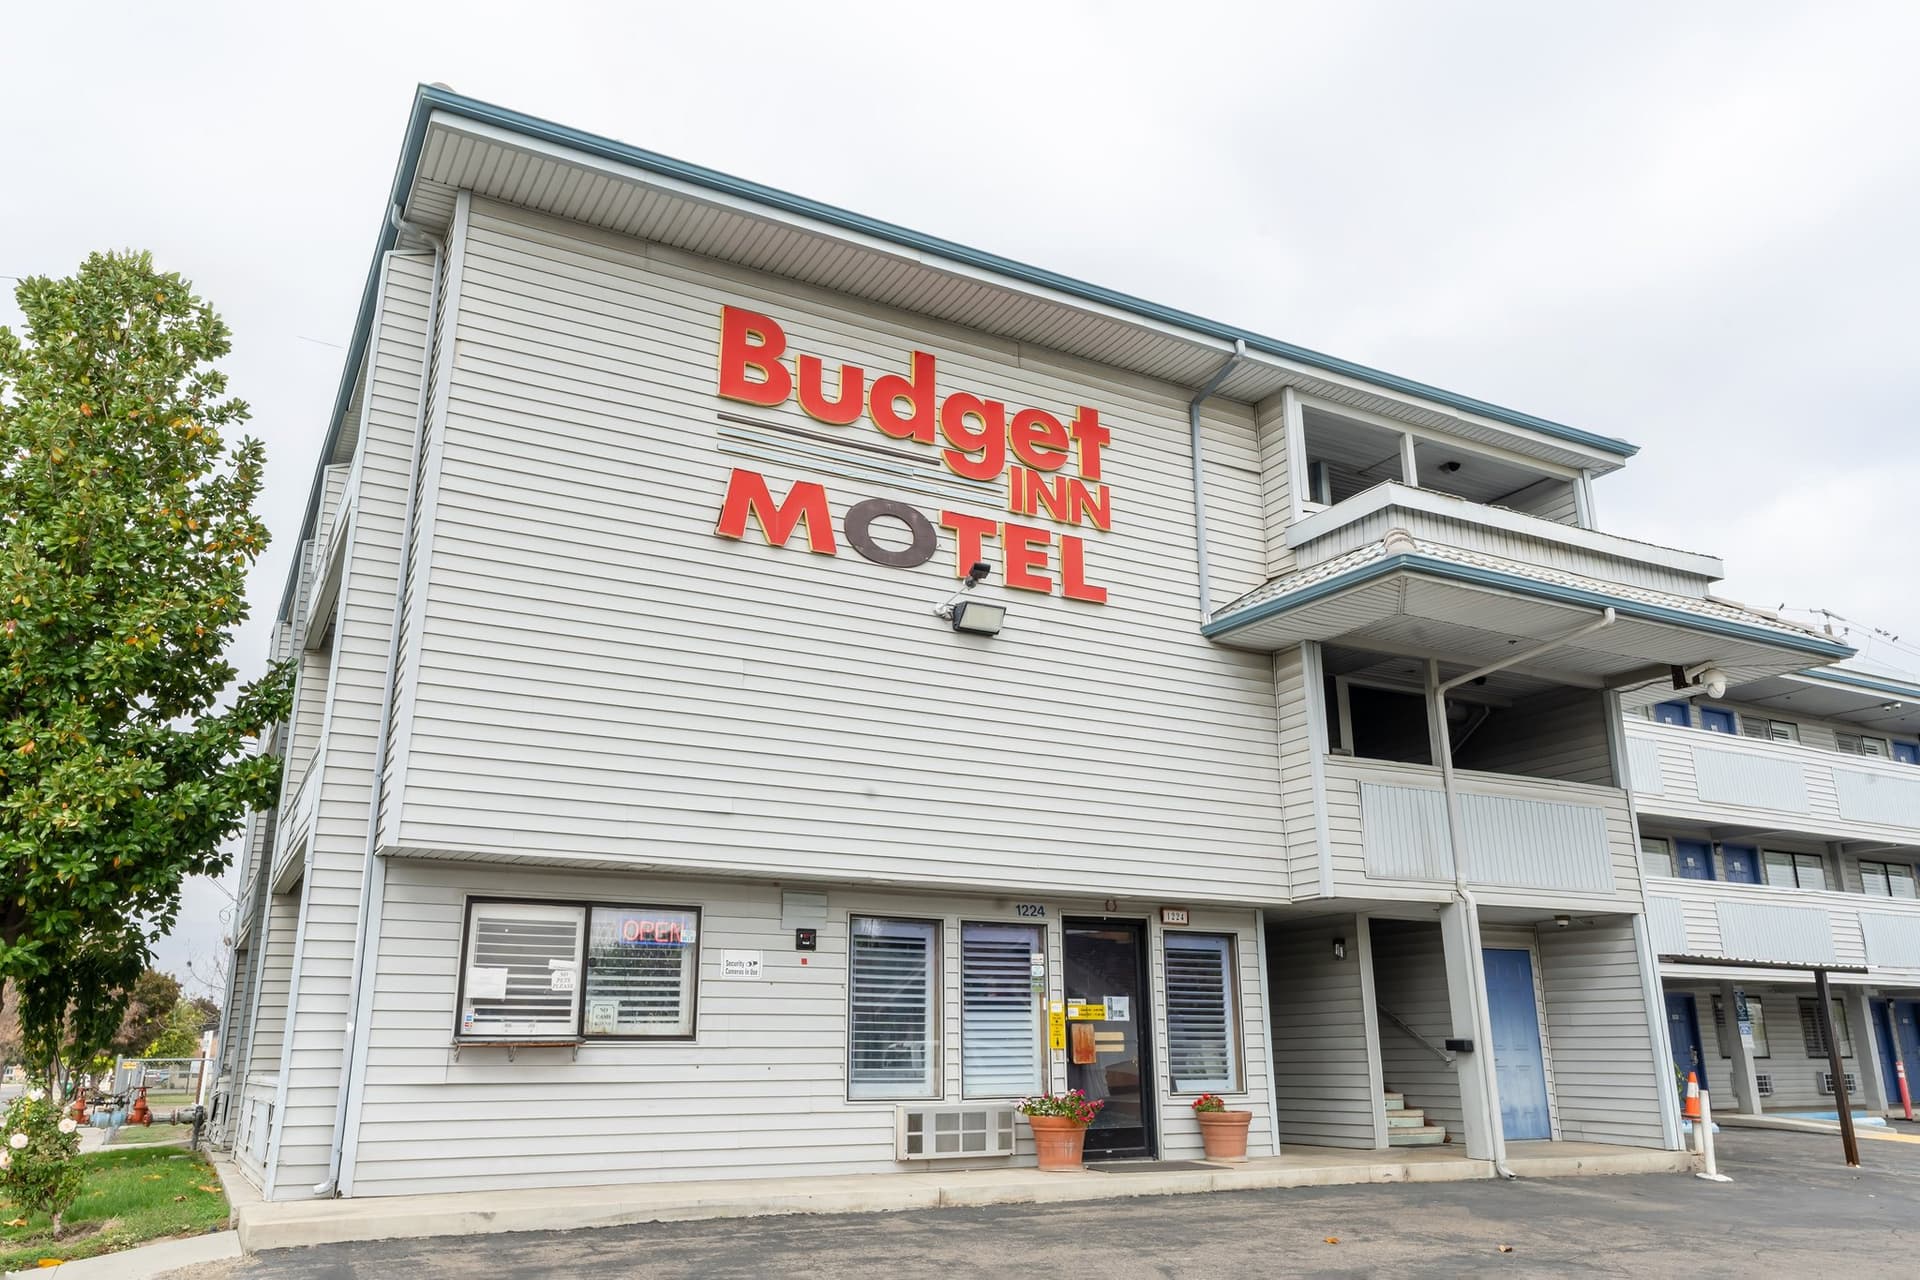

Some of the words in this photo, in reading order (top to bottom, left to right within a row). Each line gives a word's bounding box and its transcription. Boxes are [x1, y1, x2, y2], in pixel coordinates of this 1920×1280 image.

[717, 304, 1111, 482] Budget
[1008, 465, 1111, 532] INN
[714, 467, 1108, 604] MOTEL
[623, 919, 686, 943] OPEN
[1016, 904, 1045, 917] 1224
[1167, 911, 1184, 921] 1224
